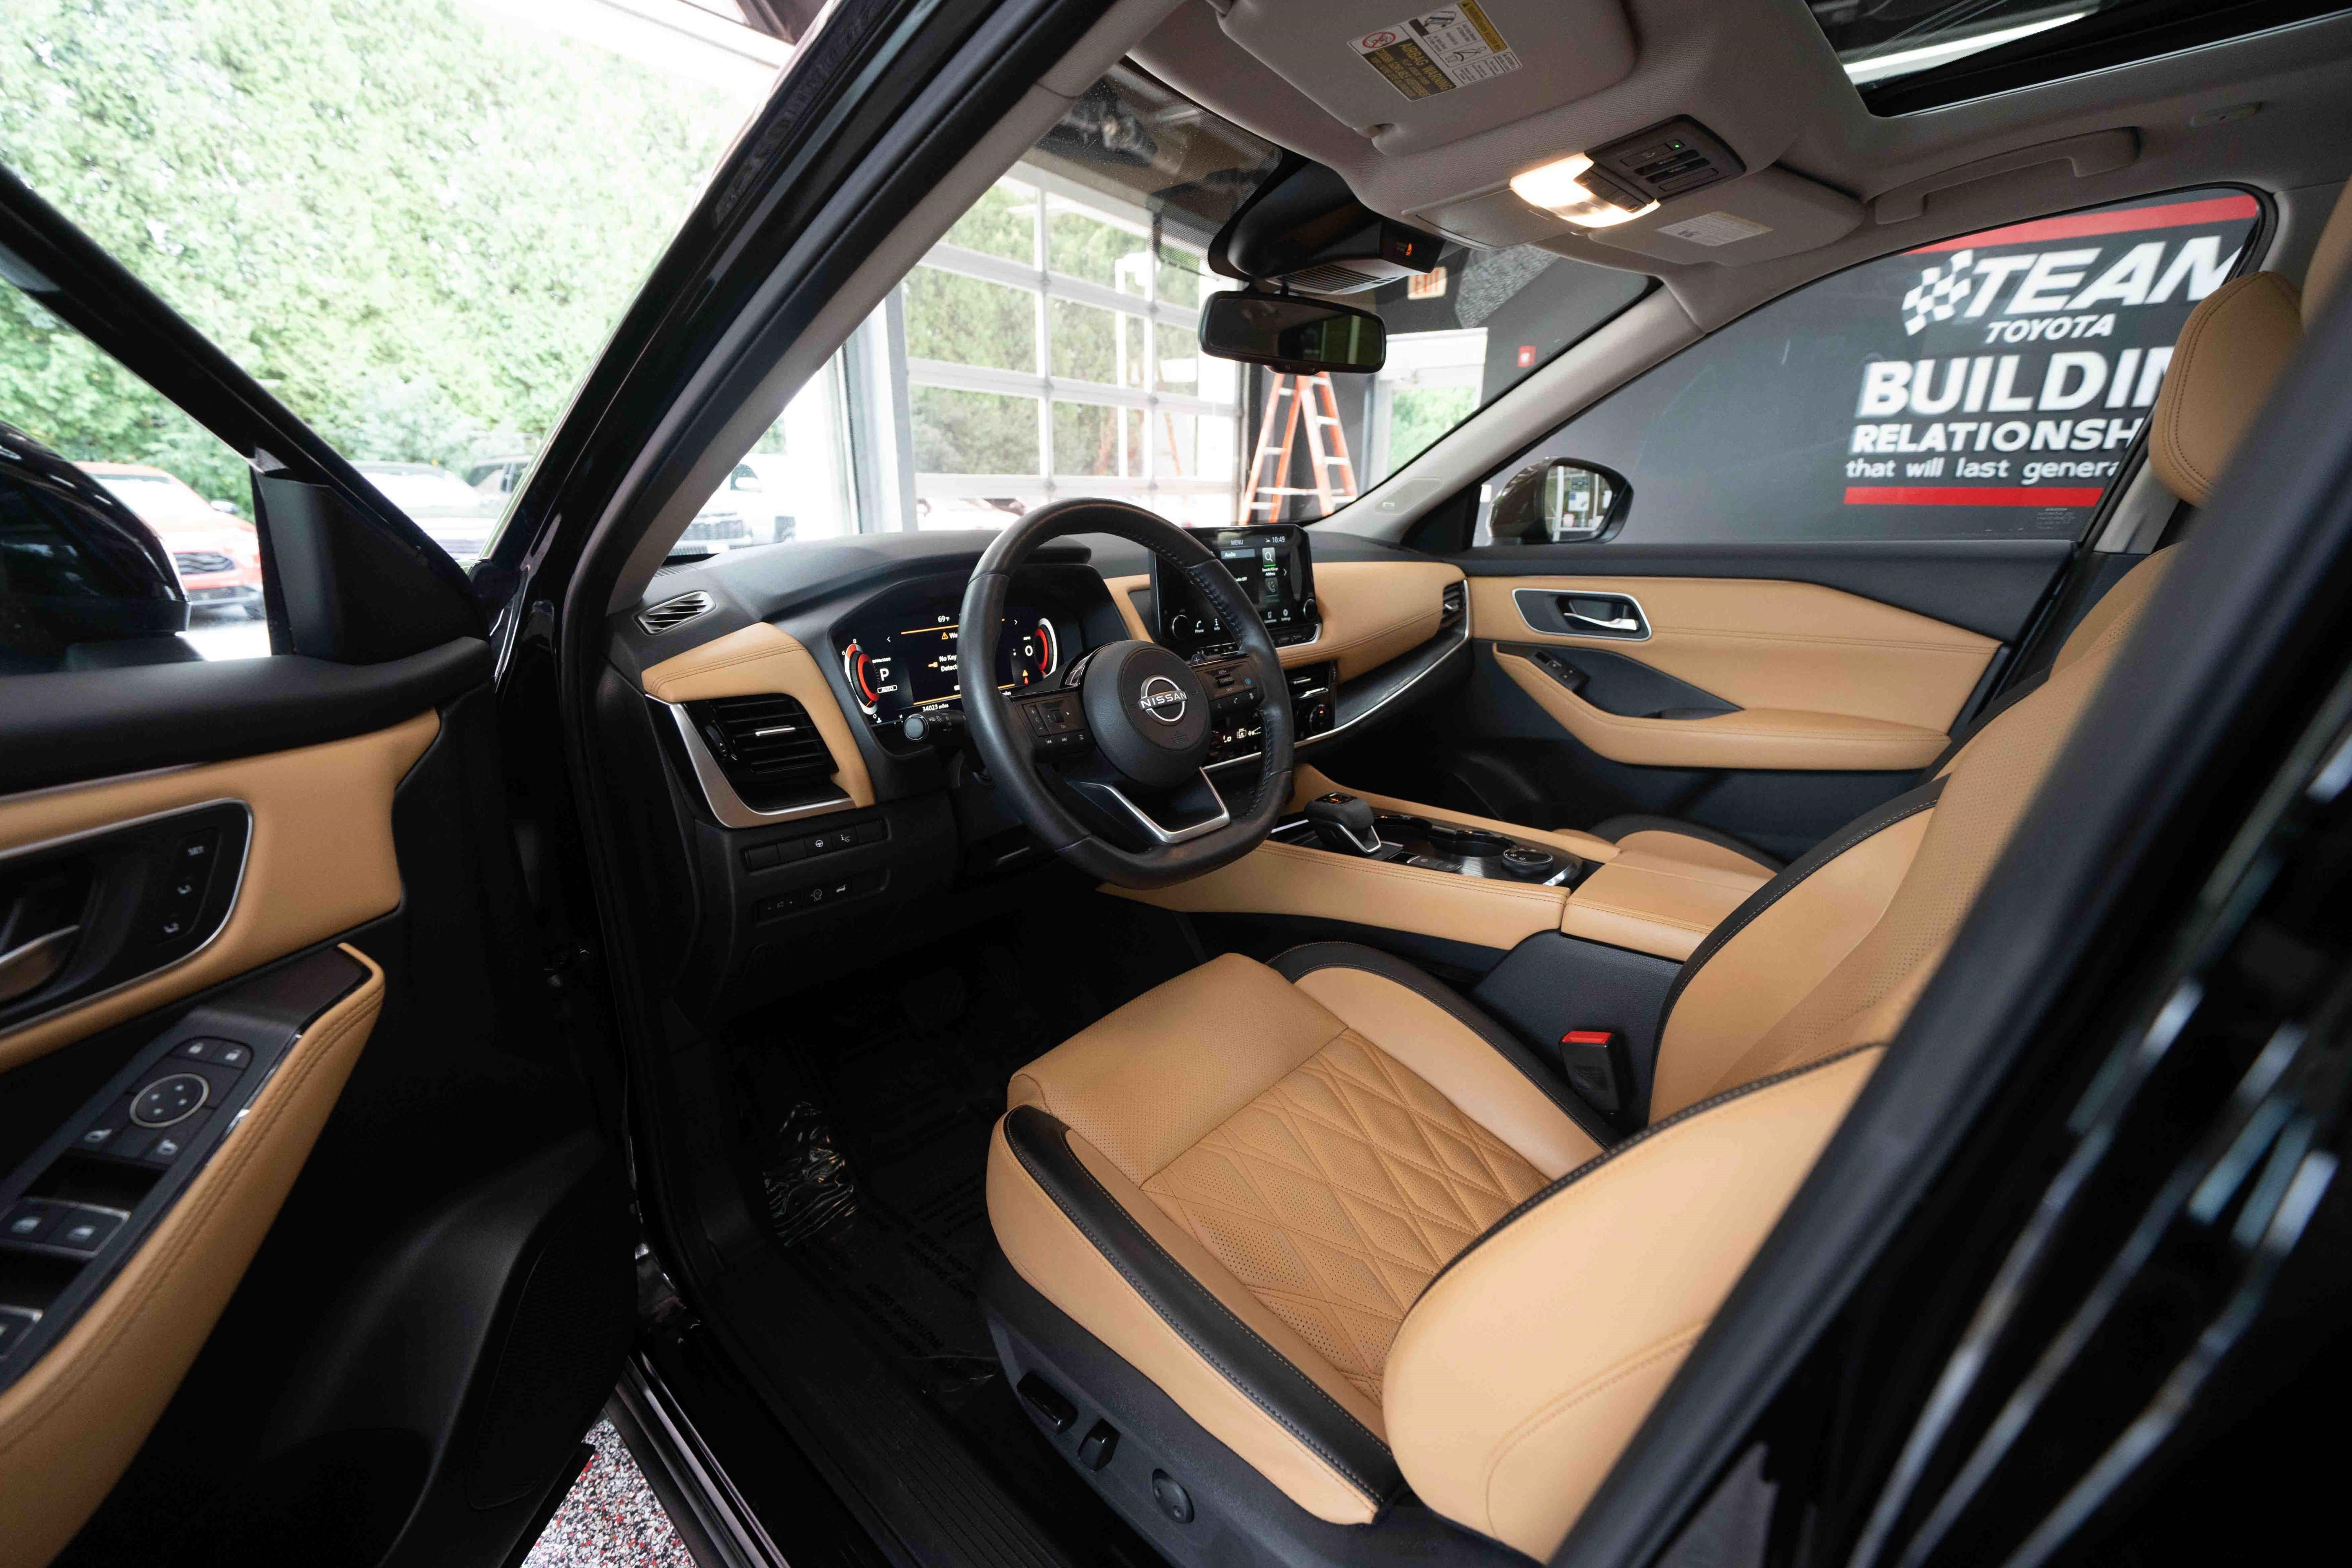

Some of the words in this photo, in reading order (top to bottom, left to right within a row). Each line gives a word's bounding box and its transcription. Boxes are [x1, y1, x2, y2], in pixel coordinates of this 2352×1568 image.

[1964, 235, 2243, 319] TEAM
[1986, 314, 2116, 344] TOYOTA
[1851, 417, 2144, 454] RELATIONSH
[1846, 459, 1895, 478] that
[1906, 458, 1944, 478] will
[1956, 457, 2009, 479] last
[880, 668, 889, 682] P
[922, 704, 938, 713] 34023
[1140, 691, 1187, 709] NISSAN
